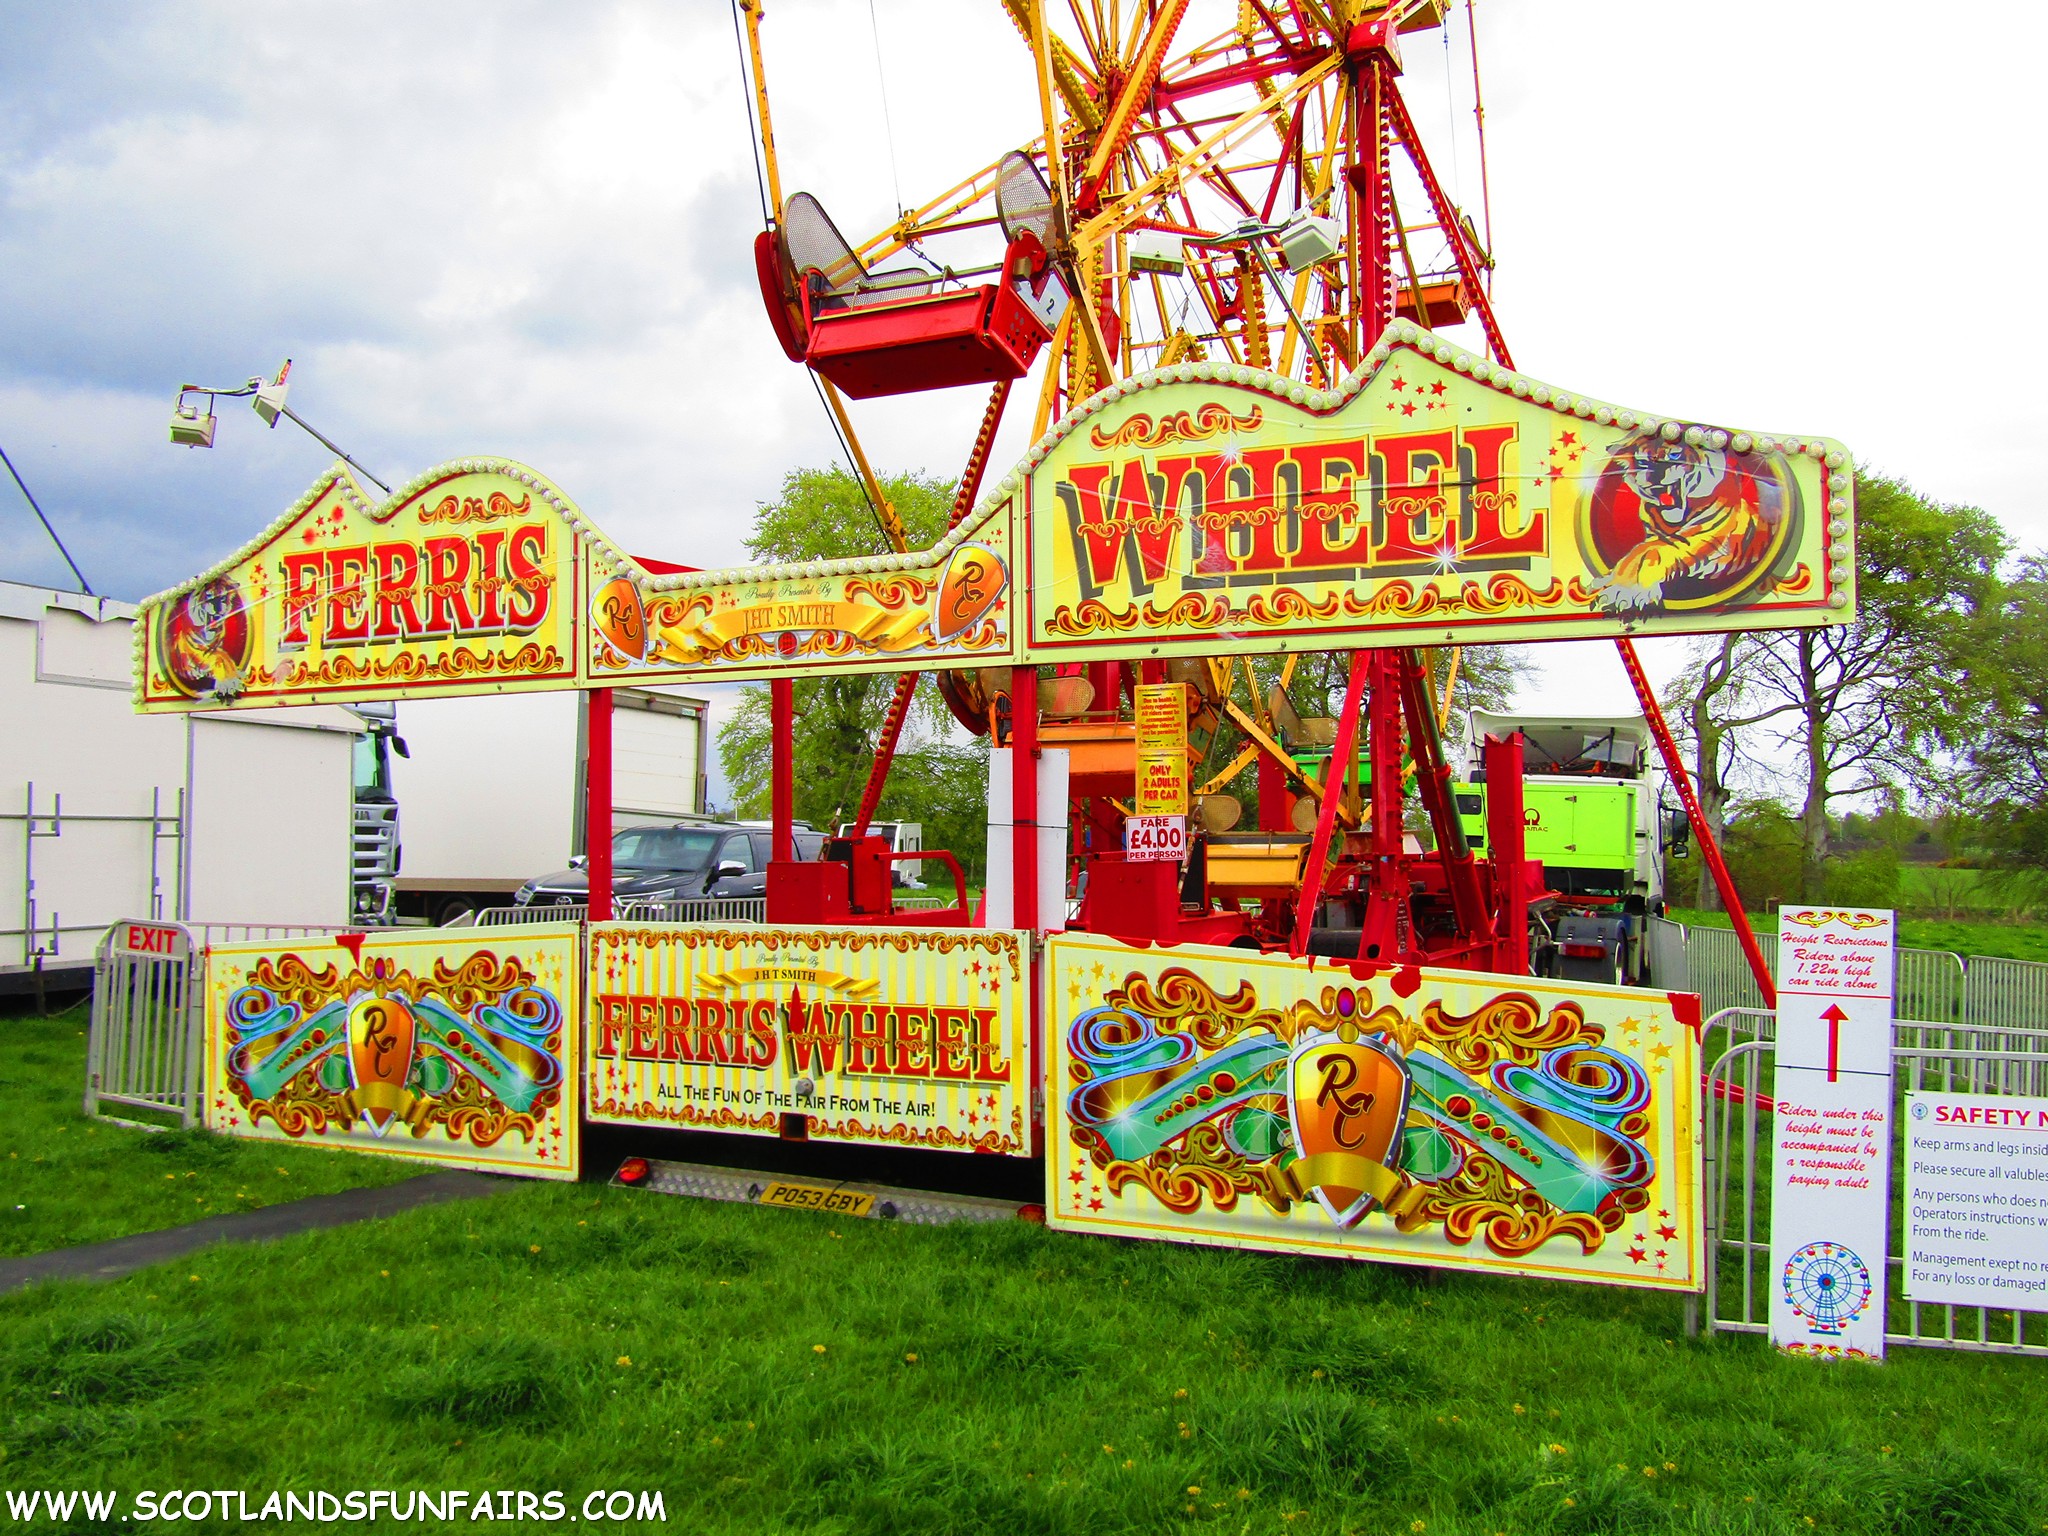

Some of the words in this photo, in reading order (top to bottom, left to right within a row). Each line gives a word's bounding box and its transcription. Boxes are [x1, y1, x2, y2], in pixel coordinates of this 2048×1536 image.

[1046, 298, 1055, 316] 2
[1060, 422, 1549, 596] WHEEL
[278, 521, 553, 650] FERRIS
[745, 587, 775, 602] Proudly
[779, 584, 815, 597] Presented
[816, 581, 832, 597] By
[742, 607, 773, 636] JHT
[777, 605, 836, 626] SMITH
[1150, 764, 1171, 776] ONLY
[1144, 778, 1148, 788] 2
[1151, 777, 1180, 788] ADULTS
[1144, 790, 1158, 800] PER
[1160, 790, 1178, 800] CAR
[1140, 818, 1170, 828] FARE
[1130, 828, 1181, 849] £4.00
[1148, 850, 1183, 858] PERSON
[128, 926, 178, 953] EXIT
[1781, 932, 1819, 946] Height
[1823, 934, 1889, 947] Restrictions
[1793, 948, 1836, 960] Riders
[1840, 951, 1876, 963] above
[781, 970, 816, 982] SMITH
[1797, 963, 1840, 975] 1.22m
[1844, 965, 1872, 979] high
[1788, 978, 1810, 986] can
[1814, 977, 1840, 987] ride
[1844, 977, 1878, 989] alone
[596, 994, 778, 1070] FERRIS
[784, 998, 1012, 1084] WHEEL
[1777, 1102, 1818, 1118] Riders
[1822, 1107, 1858, 1120] under
[1861, 1108, 1884, 1122] this
[1936, 1106, 2032, 1126] SAFETY
[1785, 1120, 1822, 1138] height
[1826, 1126, 1858, 1137] must
[1860, 1124, 1874, 1138] be
[1780, 1141, 1860, 1154] accompanied
[1863, 1142, 1878, 1158] by
[1914, 1136, 1941, 1152] Keep
[1944, 1141, 1970, 1152] arms
[1973, 1141, 1994, 1153] and
[1997, 1141, 2020, 1156] legs
[1786, 1158, 1795, 1166] a
[1800, 1158, 1866, 1172] responsible
[1914, 1162, 1948, 1174] Please
[1950, 1166, 1986, 1178] secure
[1988, 1166, 2002, 1178] all
[1786, 1174, 1831, 1190] paying
[1834, 1176, 1870, 1189] adult
[825, 1193, 866, 1212] GBY
[1913, 1188, 1934, 1202] Any
[1936, 1192, 1980, 1203] persons
[1982, 1193, 2007, 1205] who
[2010, 1194, 2037, 1208] does
[2040, 1198, 2048, 1208] n
[1912, 1206, 1967, 1222] Operators
[1970, 1210, 2035, 1226] instructions
[1913, 1224, 1941, 1238] From
[1944, 1226, 1962, 1240] the
[1964, 1228, 1989, 1241] ride.
[1912, 1250, 1986, 1268] Management
[1988, 1259, 2020, 1272] exept
[2022, 1261, 2038, 1272] no
[1912, 1269, 1930, 1280] For
[1932, 1272, 1953, 1286] any
[1954, 1272, 1976, 1284] loss
[1978, 1276, 1990, 1286] or
[1992, 1276, 2046, 1292] damaged
